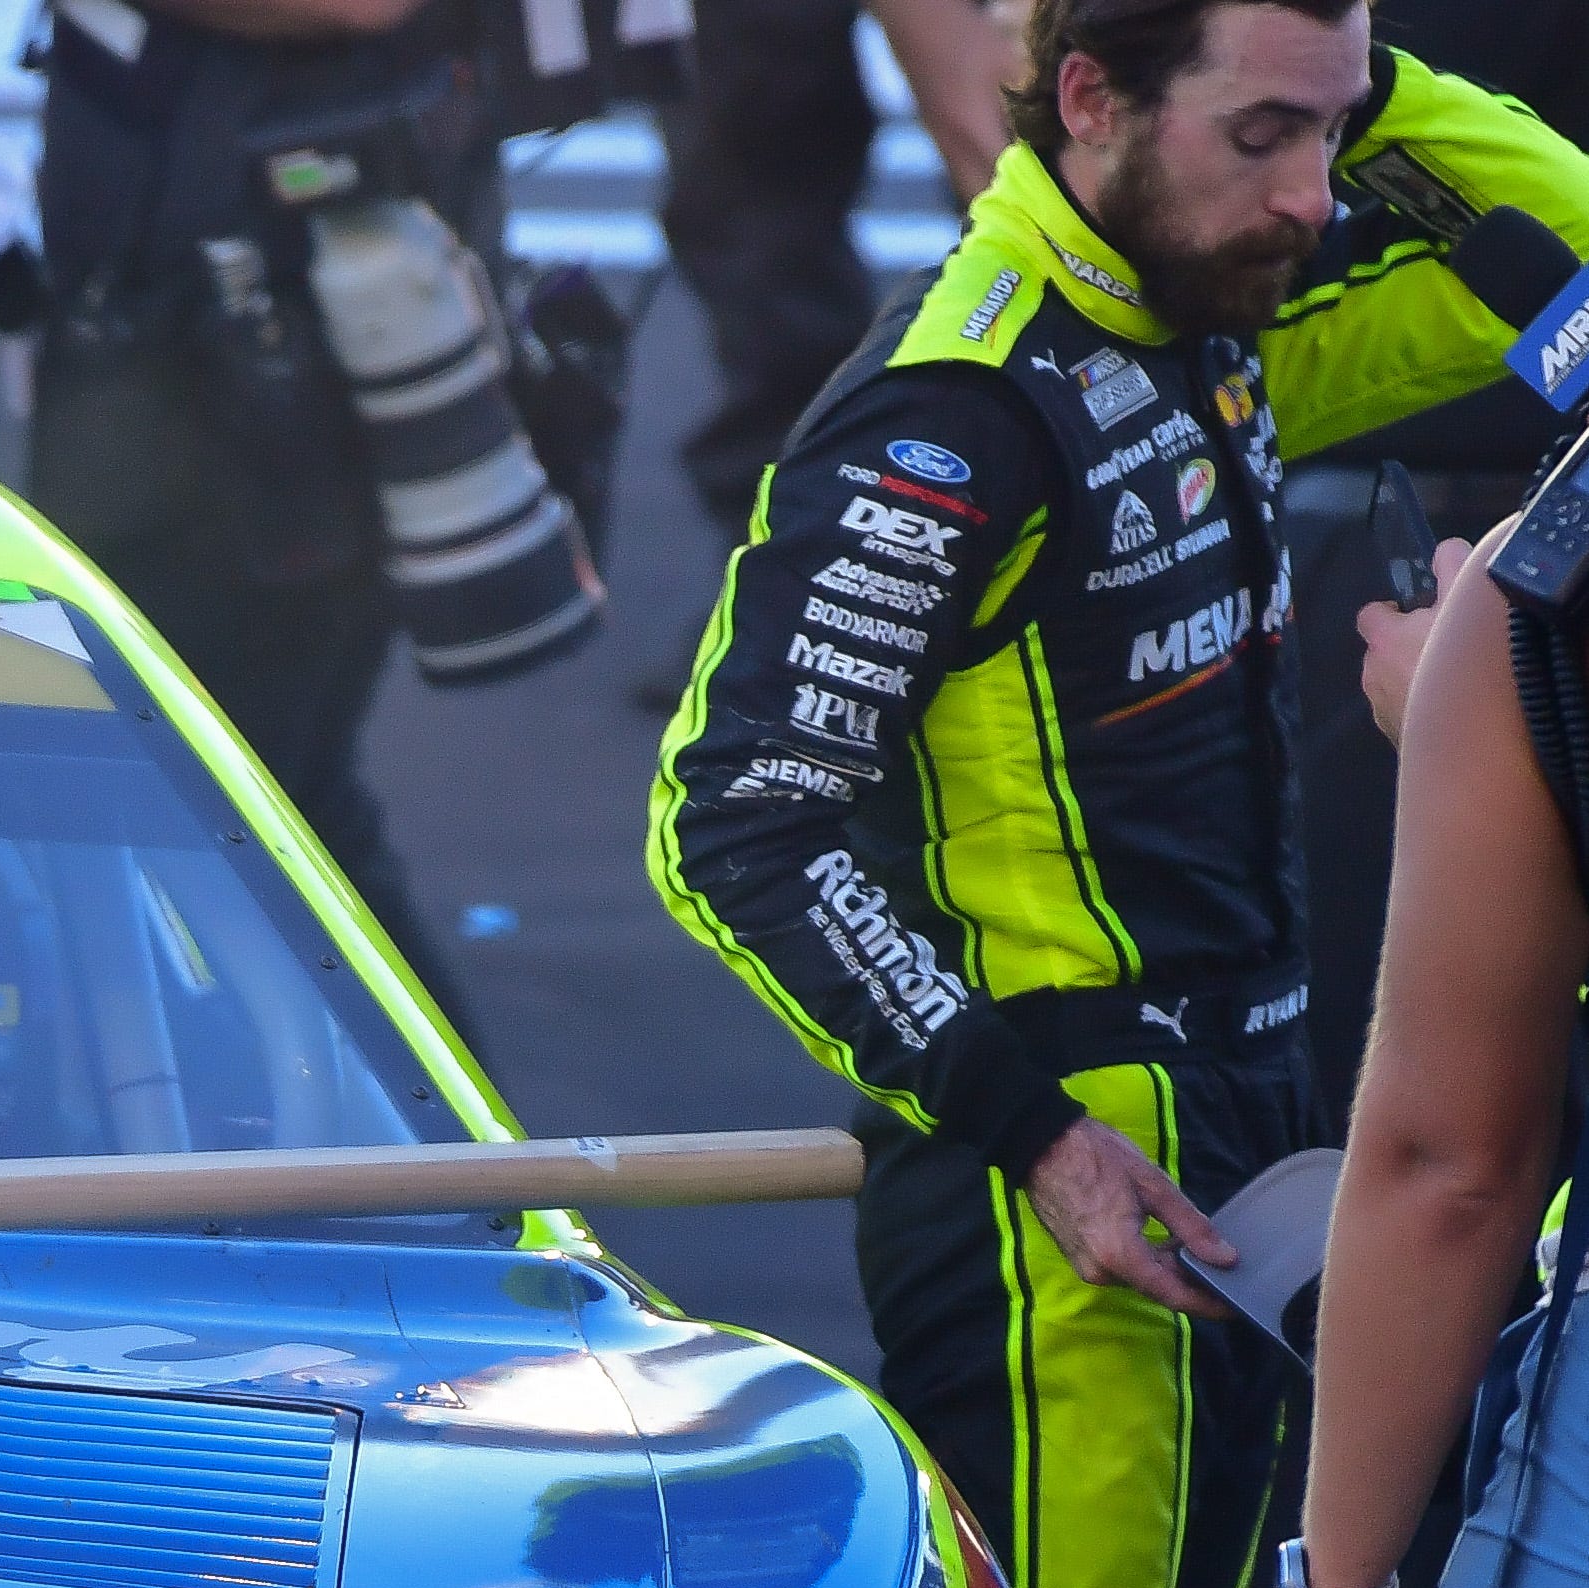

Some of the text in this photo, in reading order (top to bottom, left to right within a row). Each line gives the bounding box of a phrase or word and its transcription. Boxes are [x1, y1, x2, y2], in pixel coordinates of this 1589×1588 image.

[960, 268, 1021, 342] MENARDS
[1539, 298, 1589, 385] MR
[836, 463, 881, 485] FORD
[901, 445, 954, 477] Ford
[839, 495, 964, 558] DEX
[860, 535, 957, 577] imaging
[803, 595, 929, 654] BODYARMOR
[786, 632, 915, 697] Mazak
[803, 849, 958, 1033] Richmon
